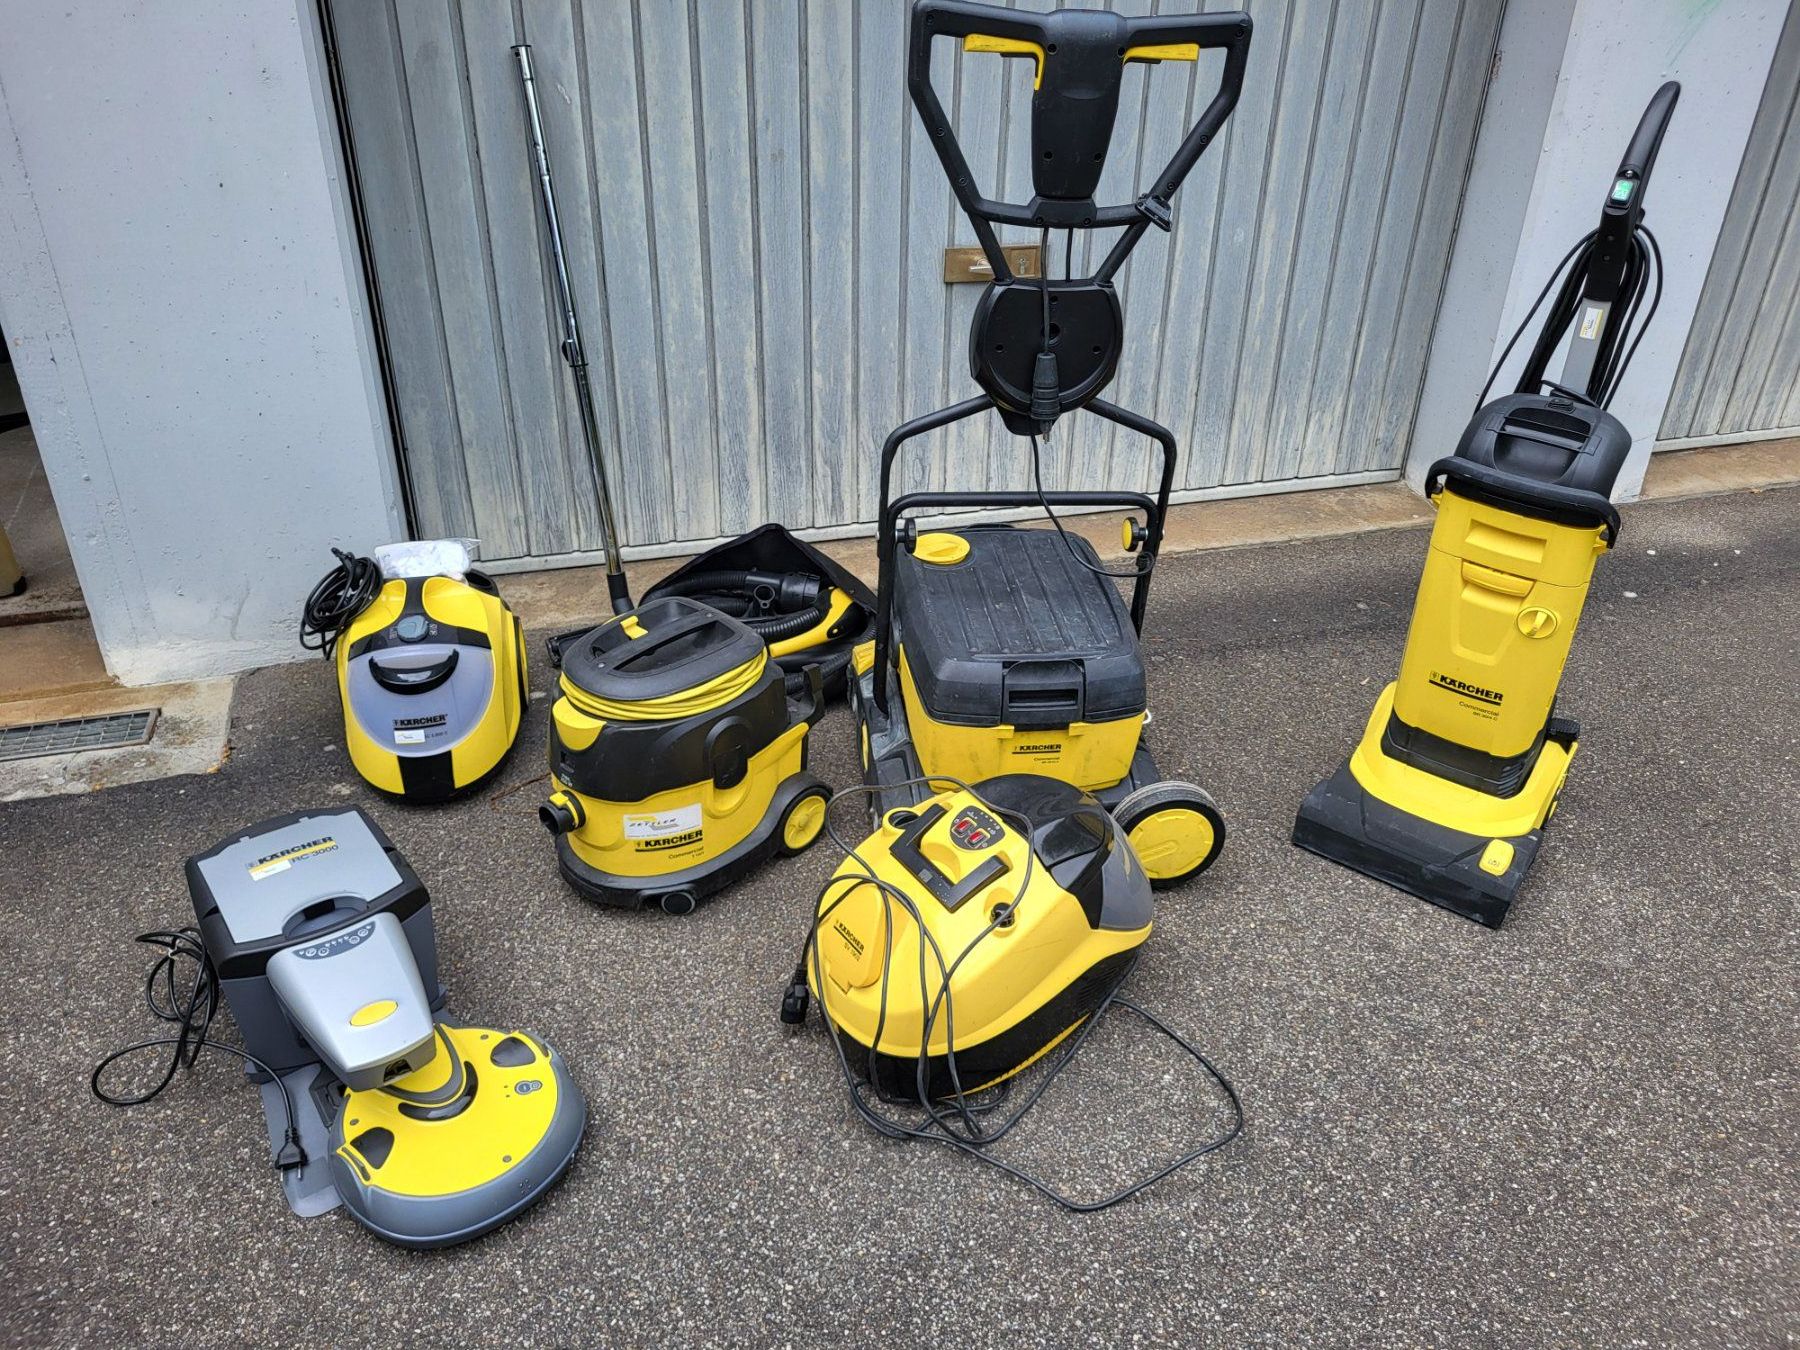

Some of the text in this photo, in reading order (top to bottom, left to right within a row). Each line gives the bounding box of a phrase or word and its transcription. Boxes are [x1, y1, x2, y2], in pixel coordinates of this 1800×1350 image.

[1440, 674, 1504, 702] KÄRCHER
[1459, 701, 1500, 717] Commercial
[645, 829, 703, 847] KÄRCHER
[312, 844, 338, 856] 3000
